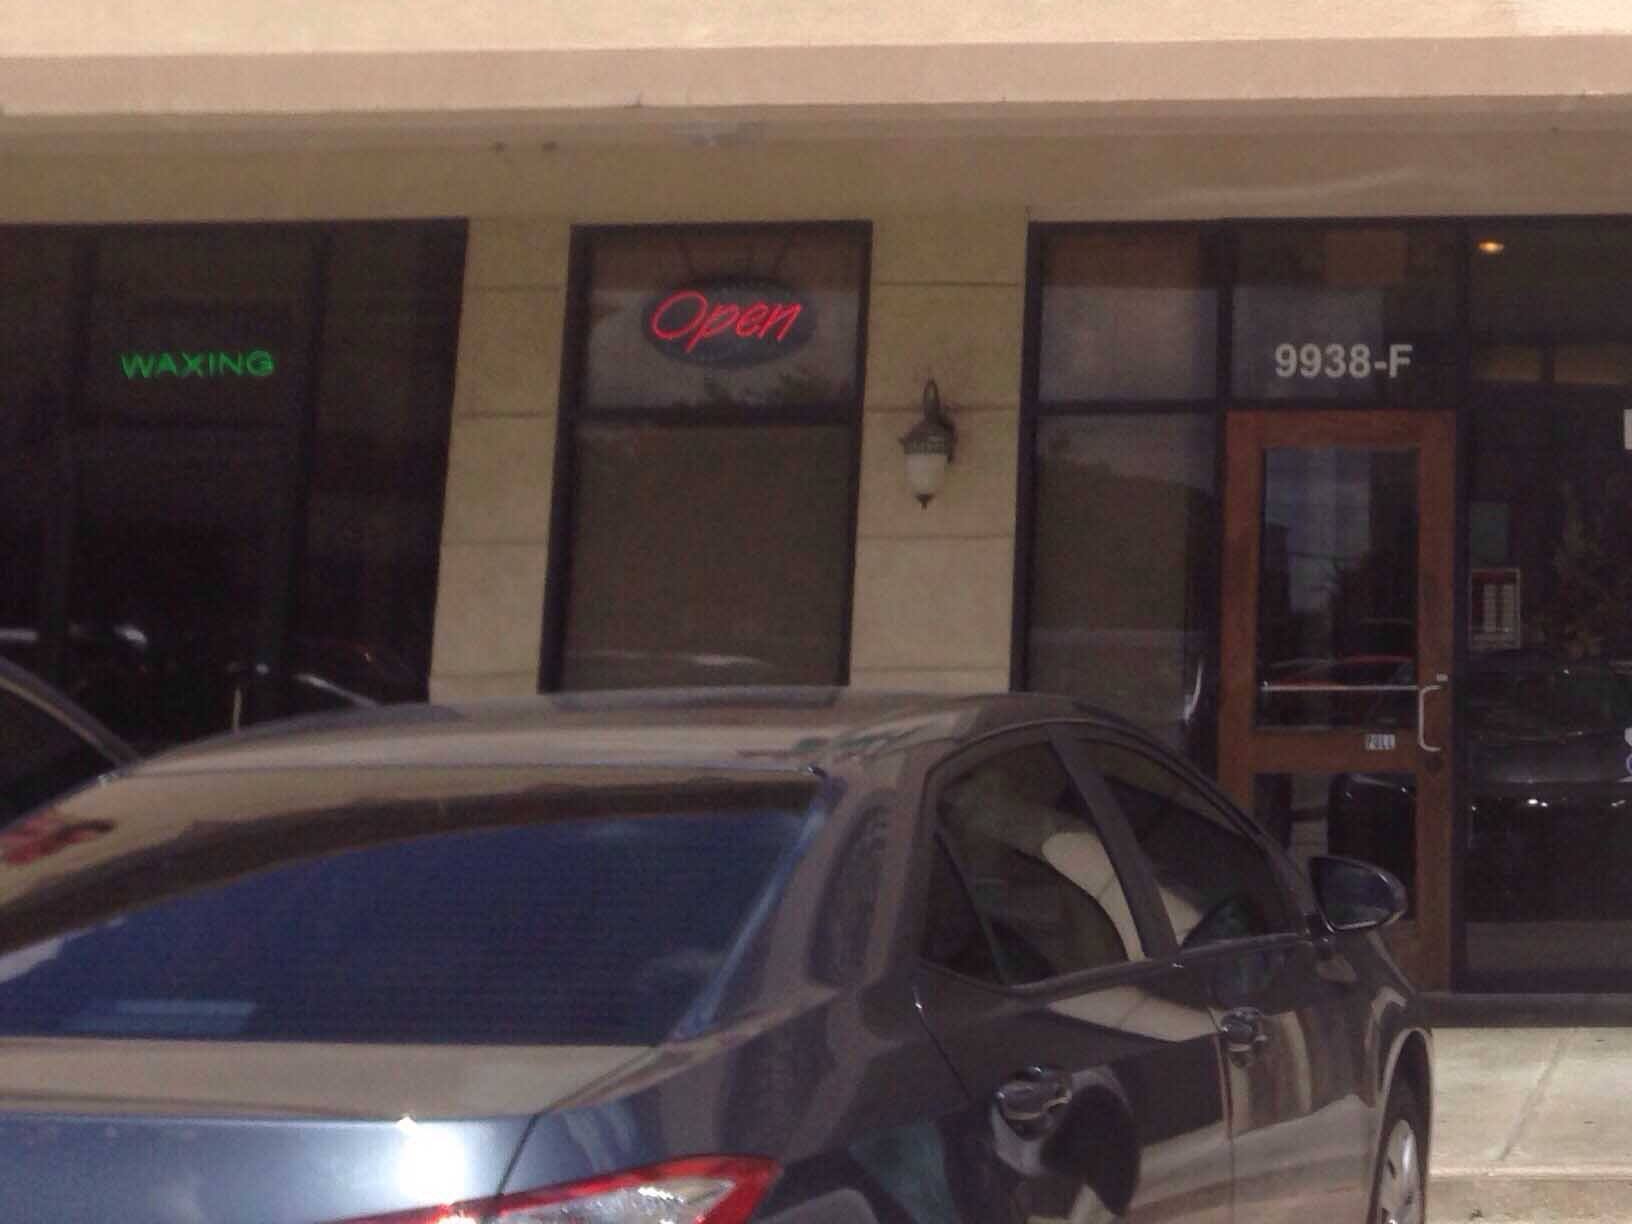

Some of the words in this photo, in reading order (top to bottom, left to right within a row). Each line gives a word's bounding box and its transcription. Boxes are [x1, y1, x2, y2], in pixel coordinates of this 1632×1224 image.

[652, 289, 802, 353] Open
[120, 350, 273, 378] WAXING
[1275, 343, 1413, 378] 9938-F
